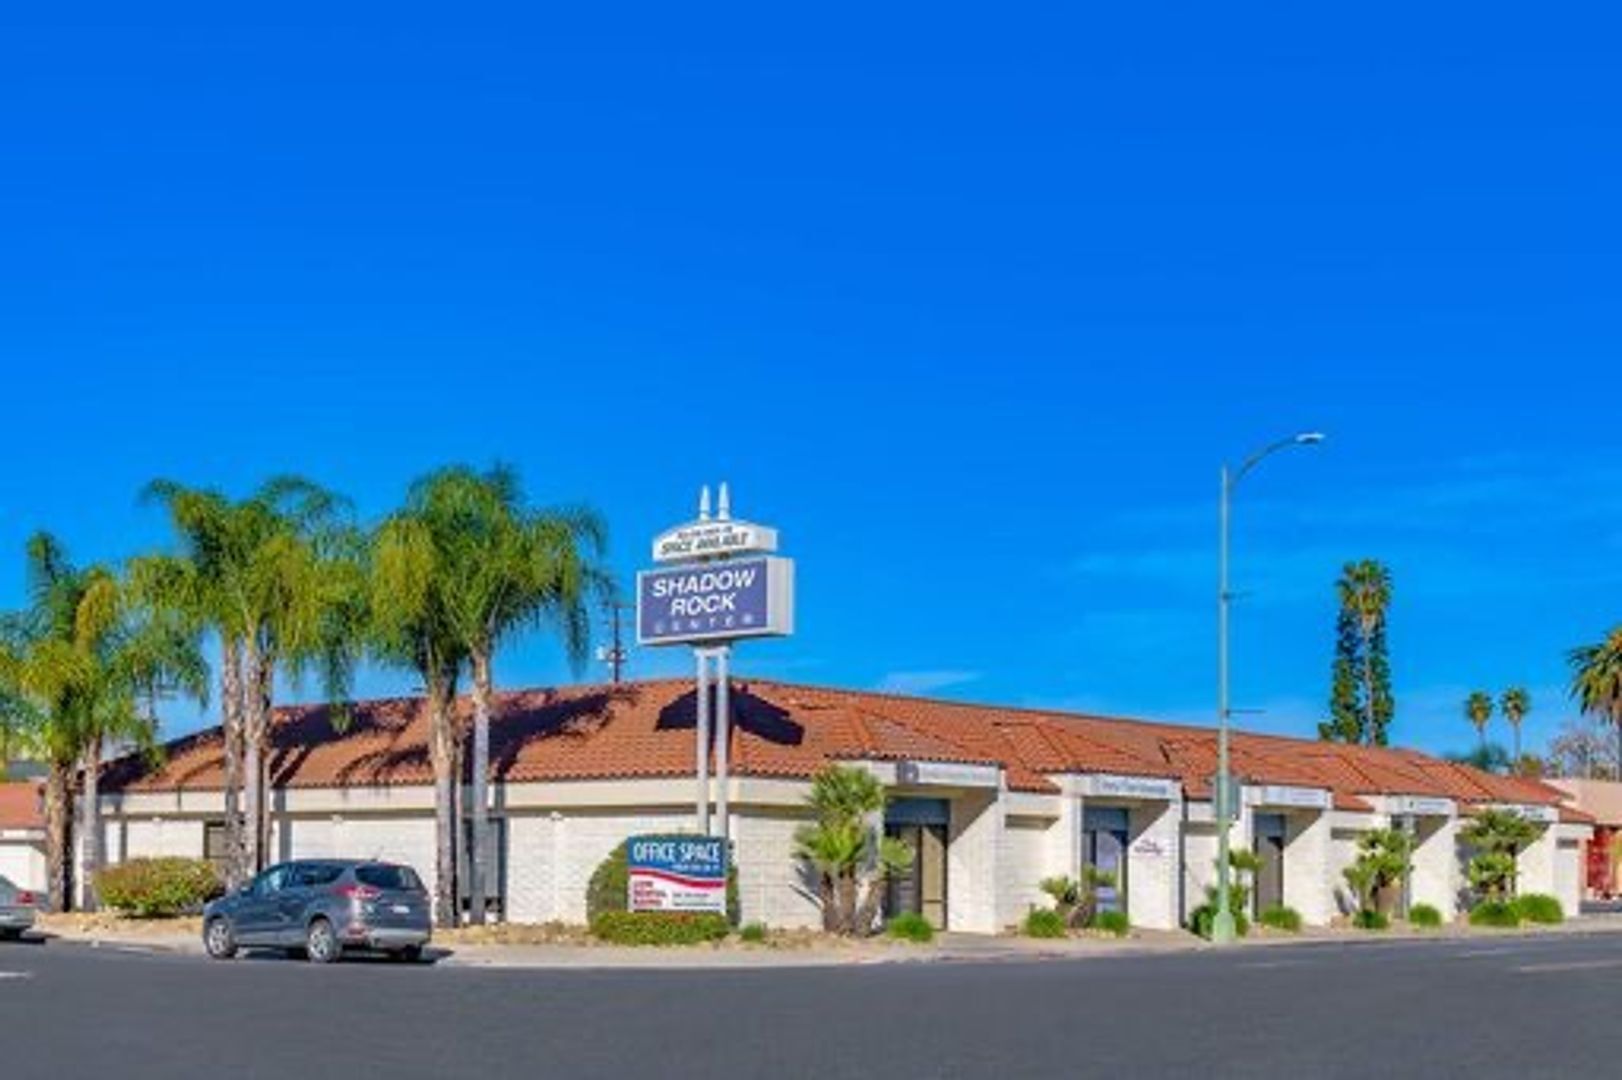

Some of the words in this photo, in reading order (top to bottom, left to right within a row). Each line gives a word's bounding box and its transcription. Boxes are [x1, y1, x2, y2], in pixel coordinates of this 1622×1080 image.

[662, 540, 692, 555] SPACE
[652, 569, 756, 598] SHADOW
[670, 593, 737, 617] ROCK
[655, 612, 754, 634] CENTER
[633, 842, 676, 863] OFFICE
[678, 842, 720, 863] SPACE
